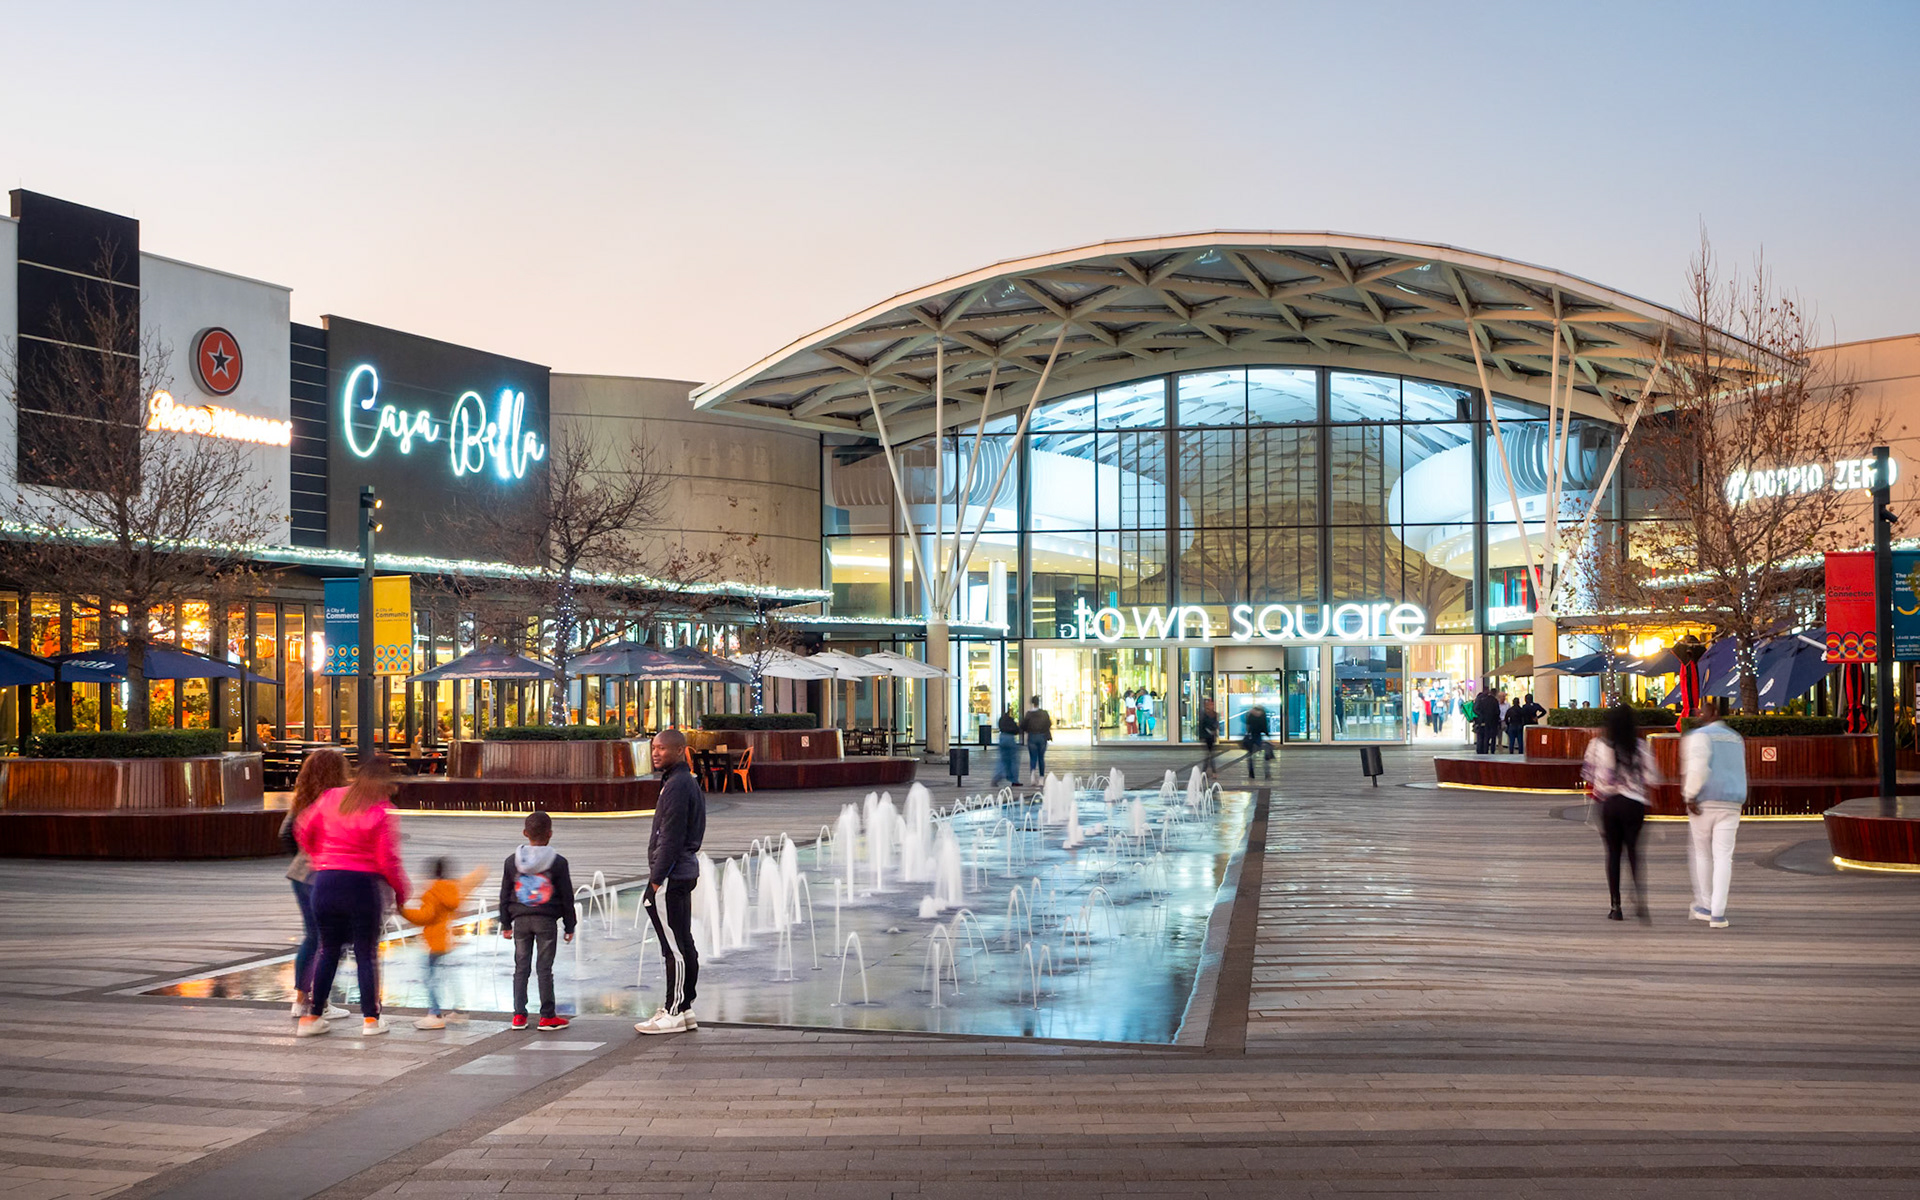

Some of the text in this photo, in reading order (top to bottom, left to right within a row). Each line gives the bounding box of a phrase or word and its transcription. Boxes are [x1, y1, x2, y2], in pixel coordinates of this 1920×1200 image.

[344, 364, 545, 479] Casa Bella
[1753, 463, 1824, 498] DOPPIO
[1073, 597, 1426, 642] town square
